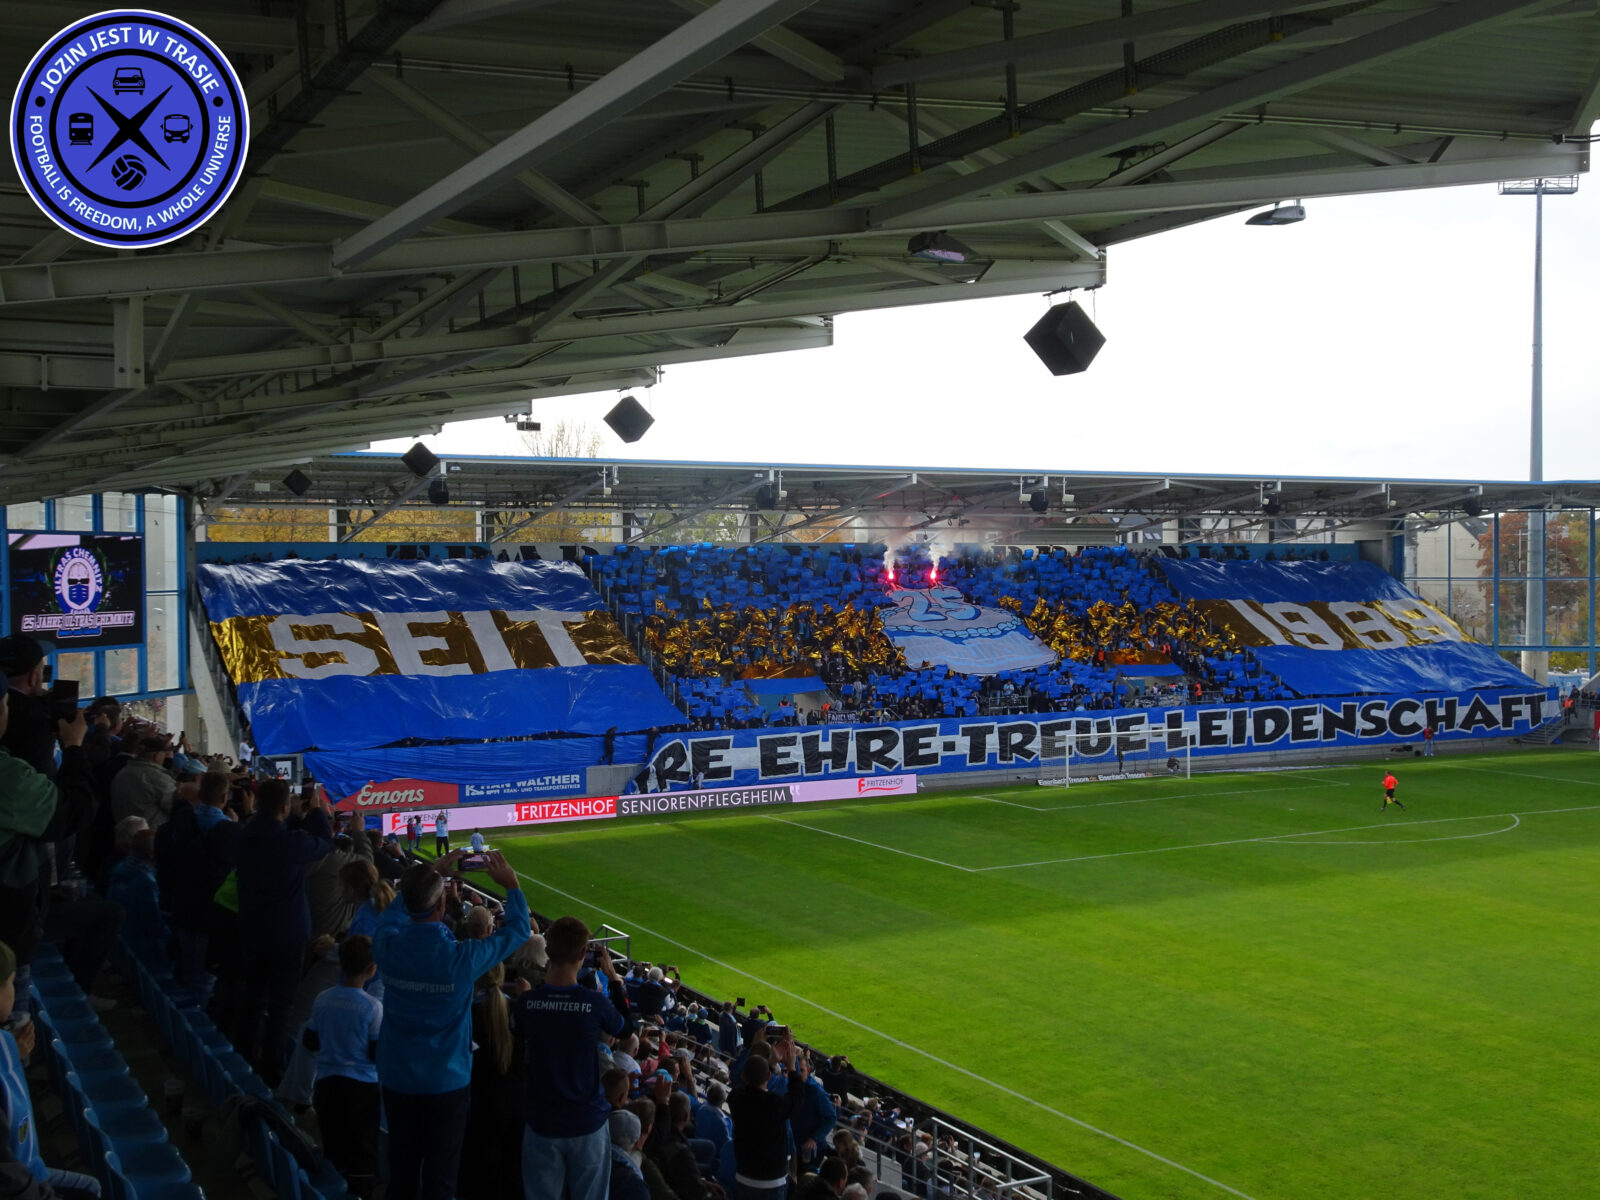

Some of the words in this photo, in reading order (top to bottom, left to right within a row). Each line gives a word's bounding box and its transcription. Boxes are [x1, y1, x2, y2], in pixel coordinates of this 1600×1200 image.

[54, 552, 72, 594] ULTRAS
[73, 547, 103, 593] CHEMNITZ
[888, 586, 981, 622] 25
[23, 617, 35, 629] 25
[37, 615, 62, 628] JAHRE
[64, 614, 94, 627] ULTRAS
[96, 612, 134, 626] CHEMNITZ
[268, 610, 589, 680] SEIT
[357, 785, 425, 806] Emons
[622, 789, 786, 815] SENIORENPFLEGEHEIM
[527, 1000, 579, 1012] CHEMNITZER
[581, 1003, 592, 1013] FC
